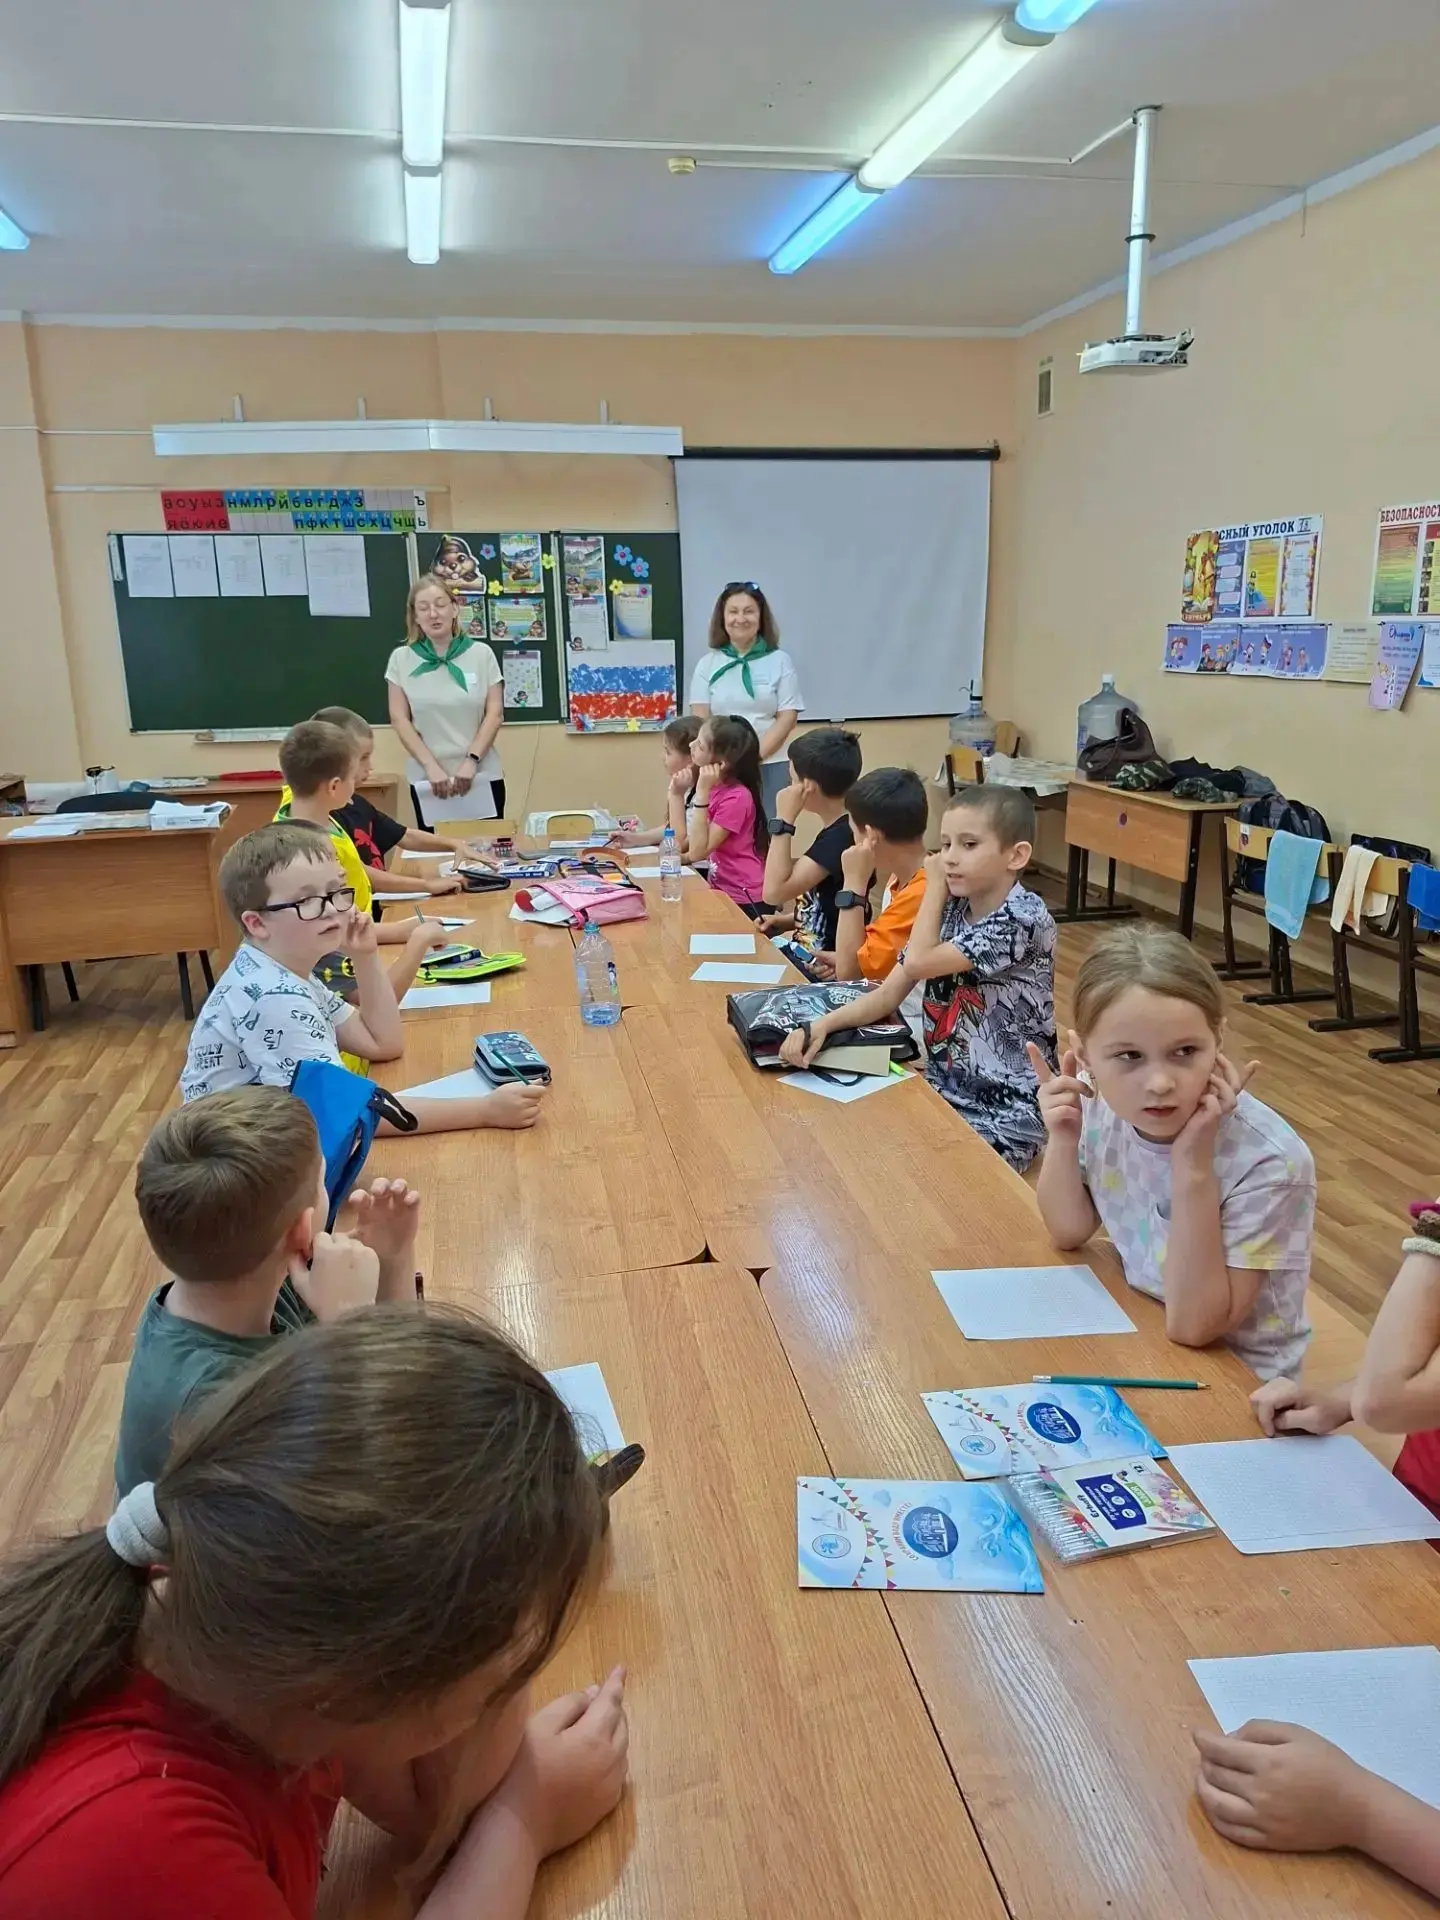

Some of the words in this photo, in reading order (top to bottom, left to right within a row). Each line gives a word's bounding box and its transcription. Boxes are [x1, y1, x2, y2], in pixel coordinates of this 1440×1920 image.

[1216, 524, 1250, 541] СНЫЙ
[1253, 520, 1295, 537] УГОЛОК
[263, 1028, 277, 1051] RUN
[1133, 1464, 1145, 1473] 12
